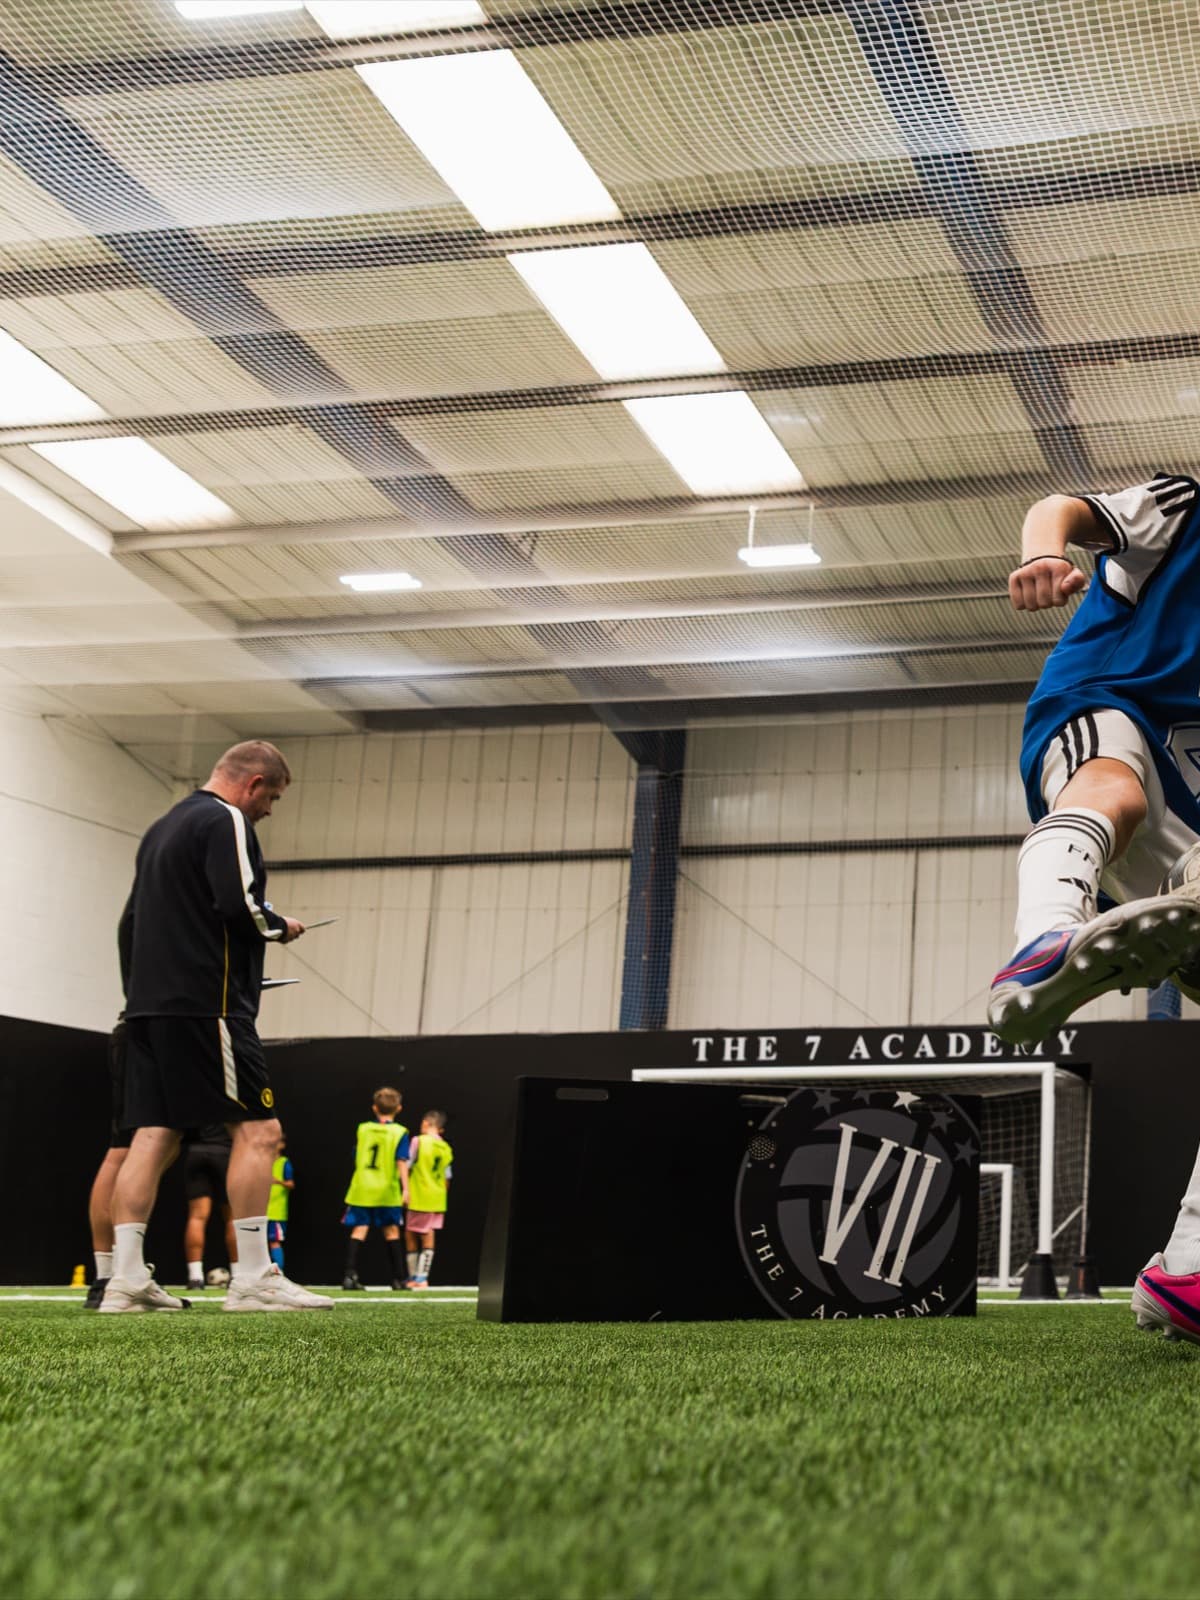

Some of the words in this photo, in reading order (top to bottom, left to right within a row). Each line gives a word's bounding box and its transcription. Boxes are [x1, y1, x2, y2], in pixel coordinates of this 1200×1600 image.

[692, 1035, 778, 1063] THE
[804, 1034, 822, 1061] 7
[819, 1122, 942, 1287] VII
[751, 1223, 785, 1281] THE
[789, 1286, 804, 1300] 7
[811, 1285, 946, 1320] ACEMY
